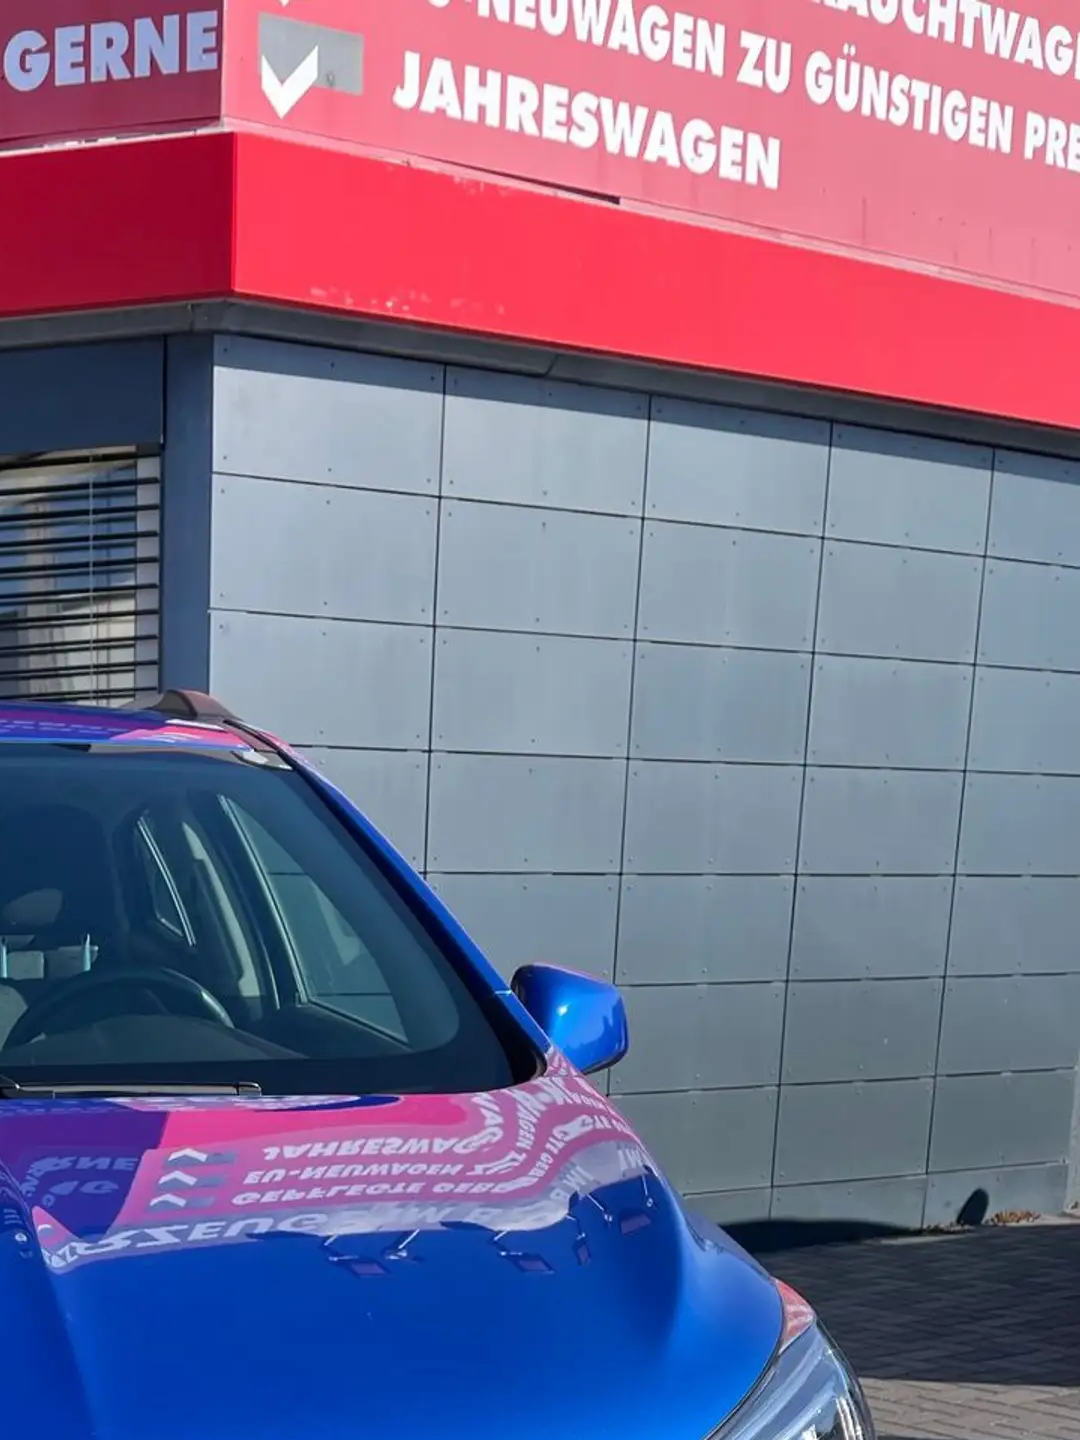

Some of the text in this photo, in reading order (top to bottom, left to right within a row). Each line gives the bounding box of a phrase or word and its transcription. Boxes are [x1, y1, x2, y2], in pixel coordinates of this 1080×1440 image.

[4, 10, 219, 92] GERNE
[736, 30, 792, 94] ZU
[805, 43, 1014, 154] GÜNSTIGEN
[392, 50, 781, 189] JAHRESWAGEN
